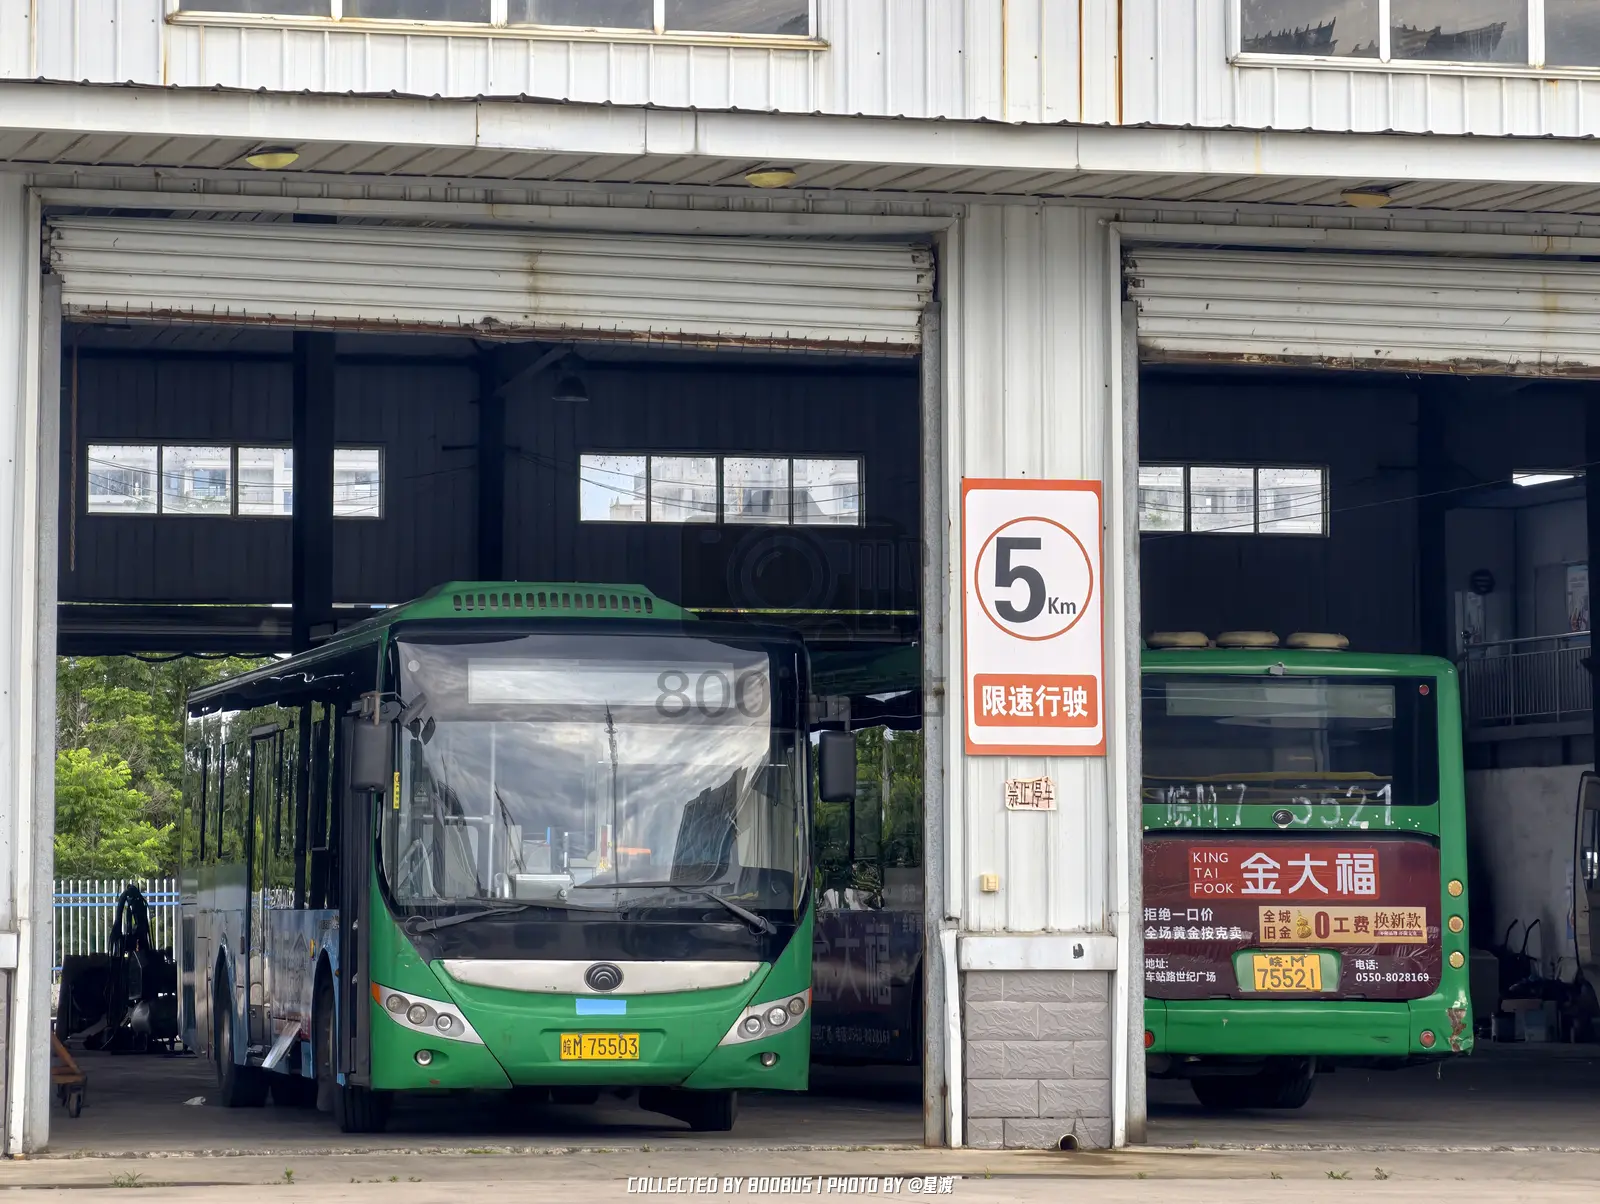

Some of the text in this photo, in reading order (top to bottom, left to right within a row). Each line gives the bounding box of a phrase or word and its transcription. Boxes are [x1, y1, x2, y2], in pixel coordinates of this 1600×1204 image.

[995, 537, 1076, 623] 5 Km
[982, 685, 1089, 717] 限速行驶
[1193, 852, 1229, 863] KING
[1194, 867, 1218, 879] TAI
[1240, 852, 1376, 895] 金大福
[1194, 883, 1234, 894] FOOK
[1144, 907, 1214, 921] 拒绝一口价
[1263, 909, 1292, 924] 全城
[1373, 912, 1422, 929] 换新款
[1144, 926, 1242, 940] 全场黄金按克卖
[1263, 926, 1292, 940] 旧金
[1355, 959, 1379, 971] 电话:
[1145, 971, 1217, 983] 车站路世纪广场
[1257, 968, 1315, 988] 75521
[1355, 972, 1430, 983] 0550-8028169
